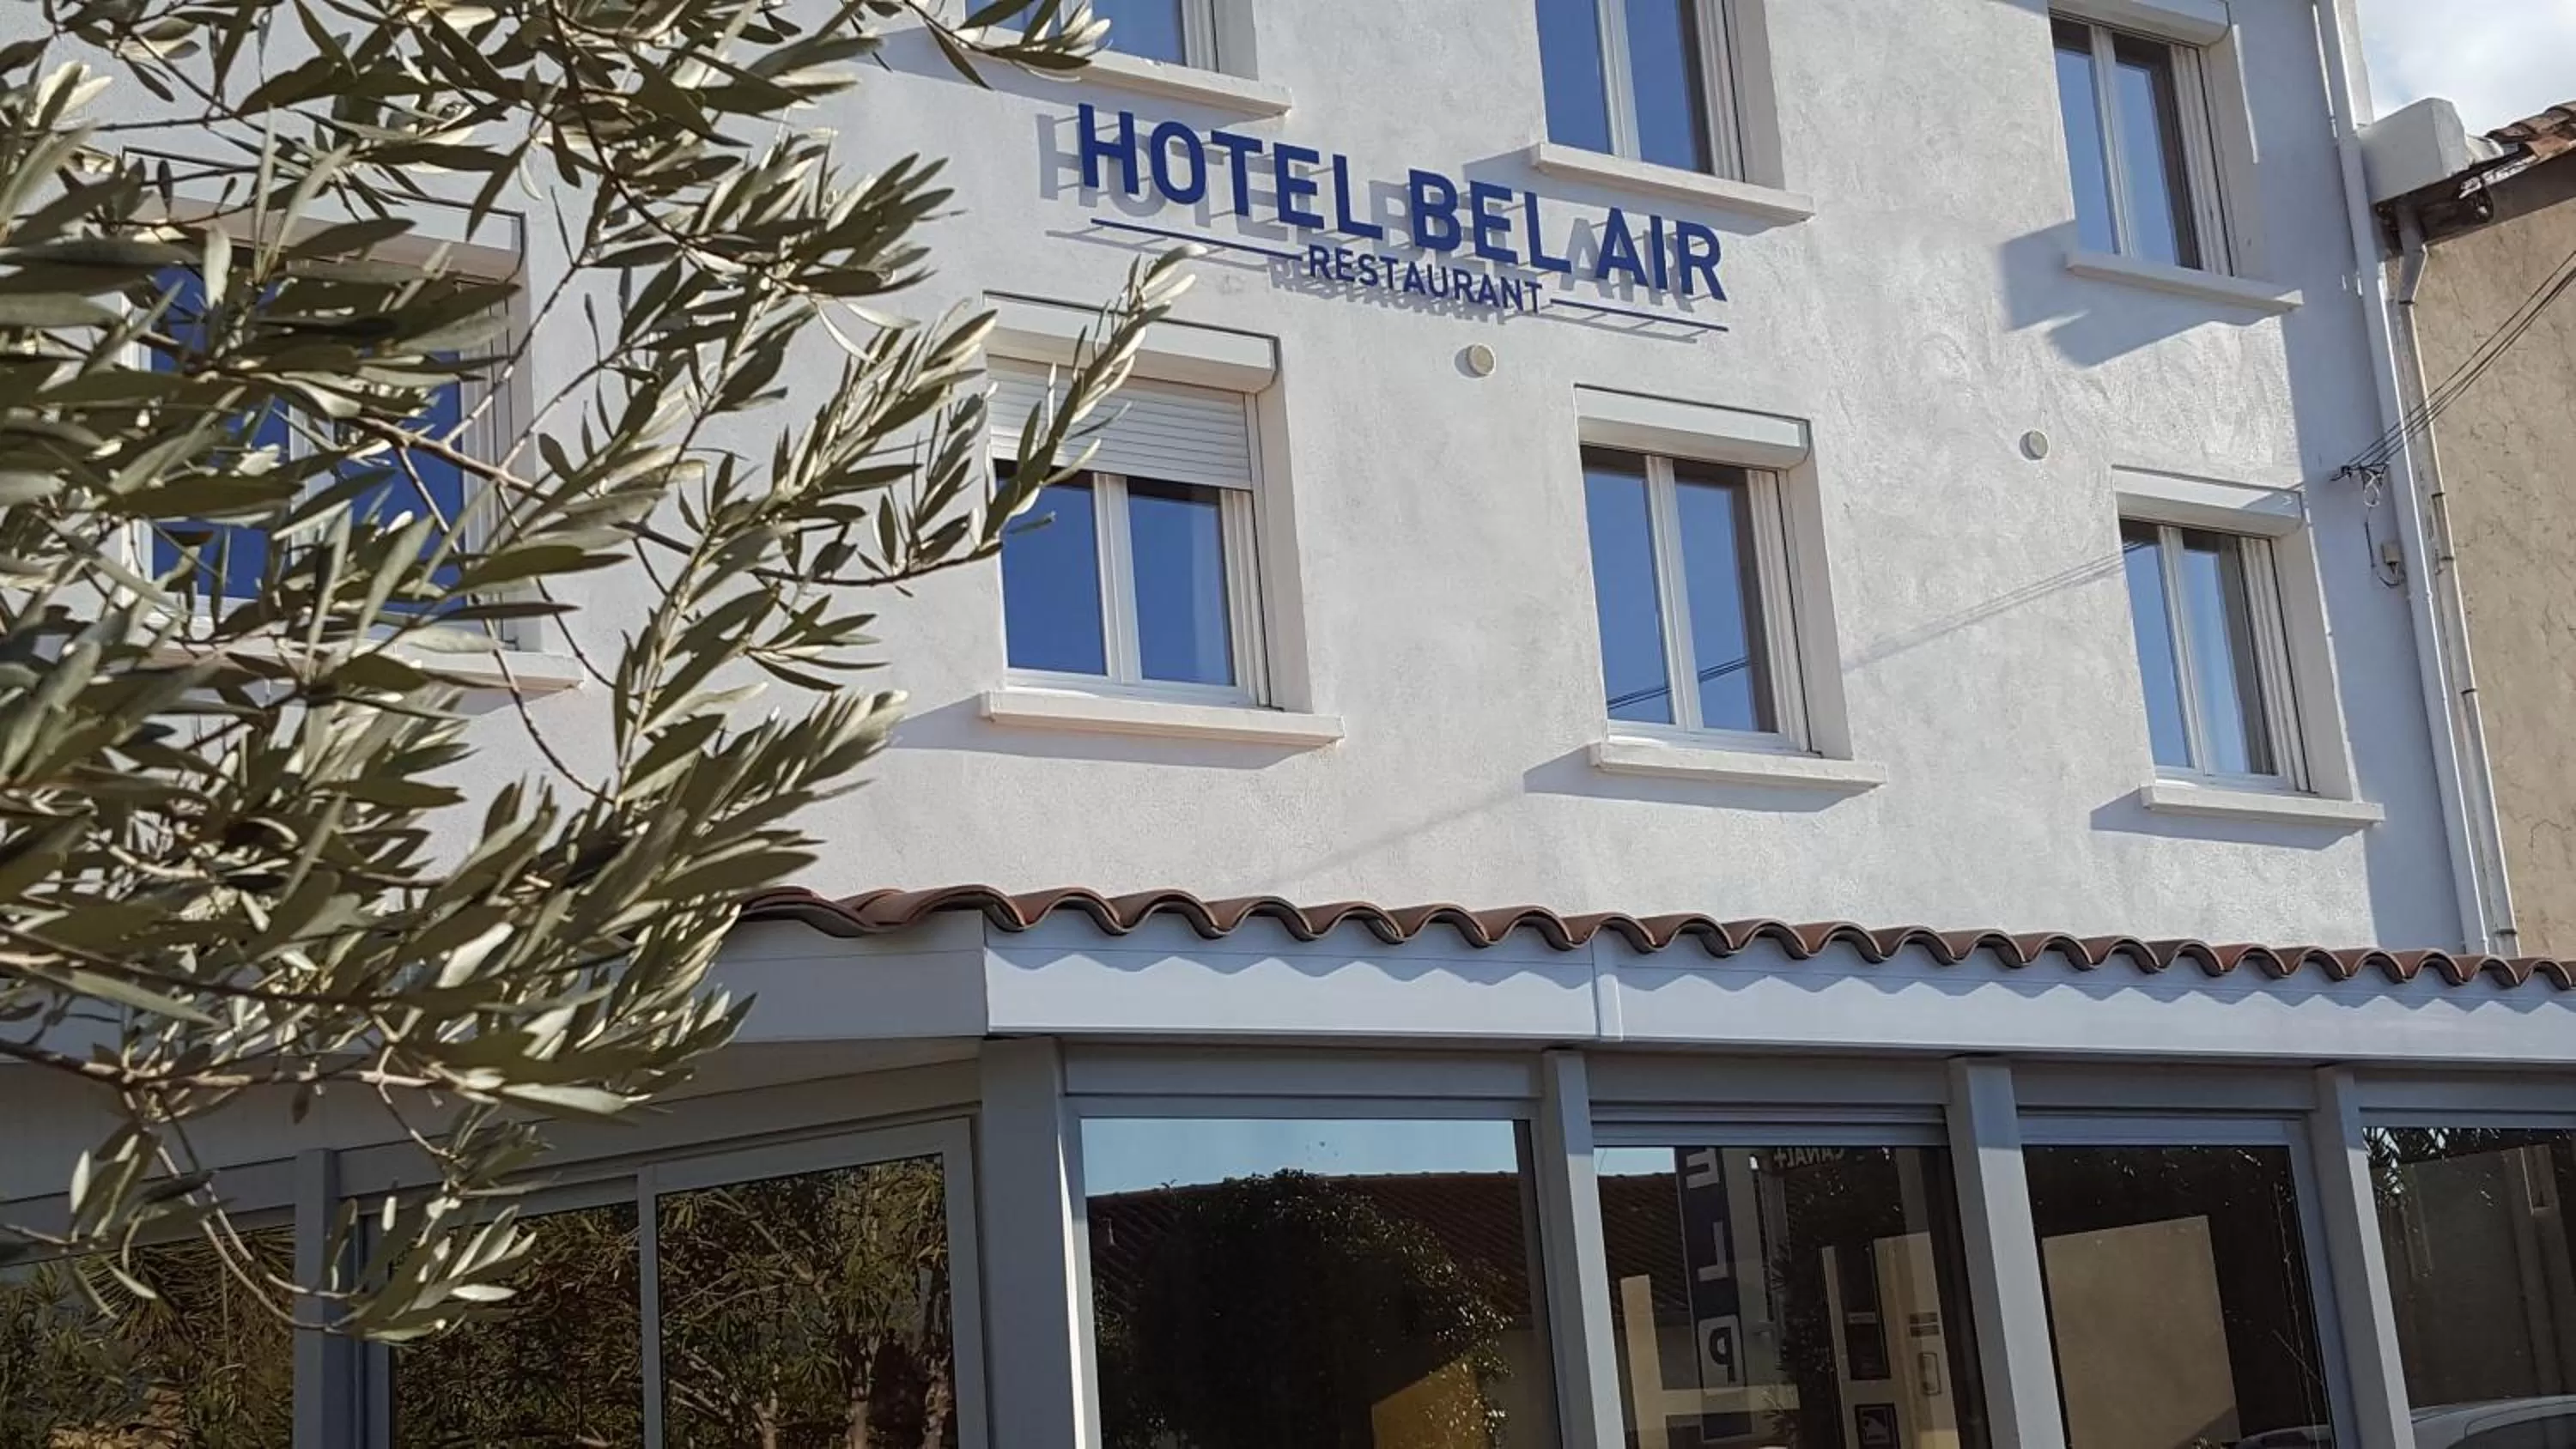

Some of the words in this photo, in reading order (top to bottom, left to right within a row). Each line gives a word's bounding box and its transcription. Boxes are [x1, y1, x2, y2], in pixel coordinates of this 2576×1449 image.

[1078, 102, 1383, 241] HOTEL
[1408, 169, 1572, 275] BEL
[1594, 207, 1727, 302] AIR
[1309, 244, 1543, 314] RESTAURANT
